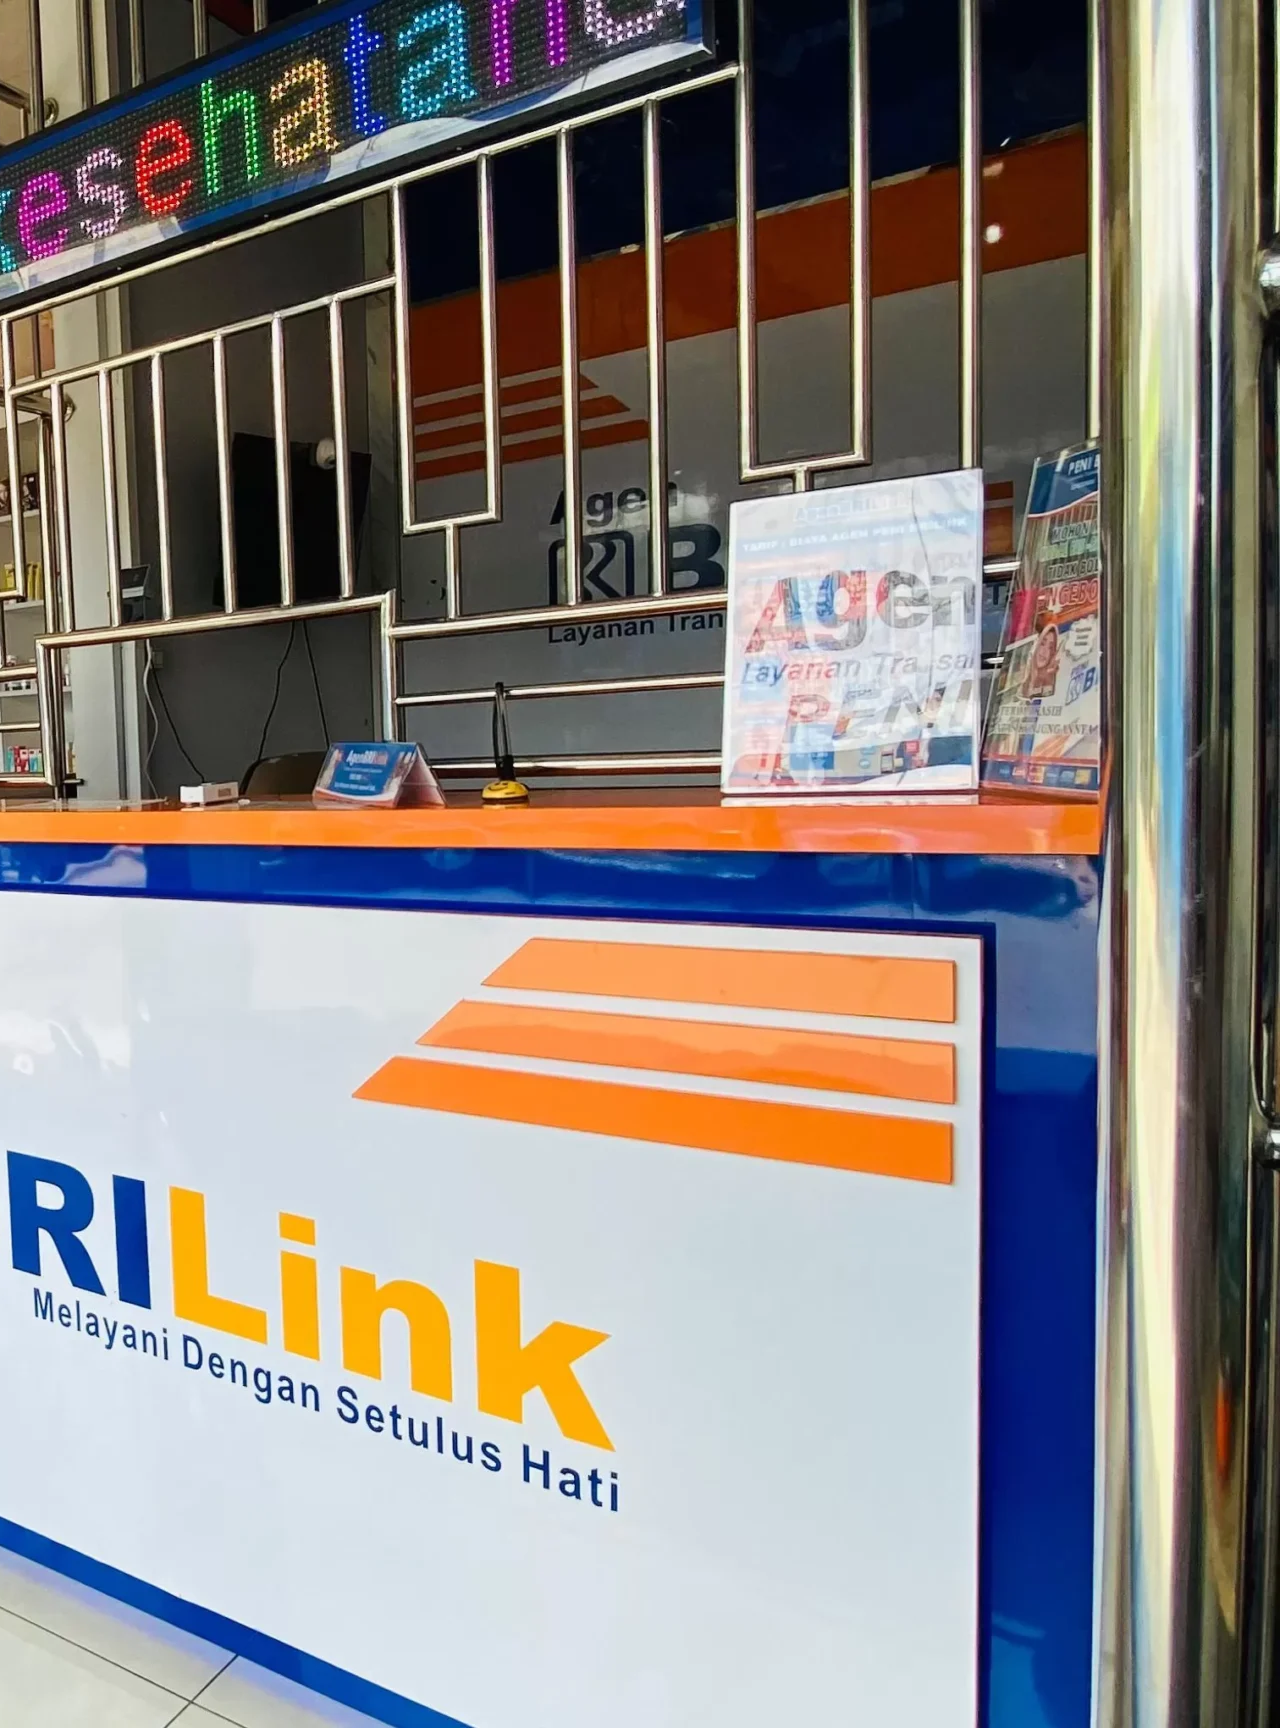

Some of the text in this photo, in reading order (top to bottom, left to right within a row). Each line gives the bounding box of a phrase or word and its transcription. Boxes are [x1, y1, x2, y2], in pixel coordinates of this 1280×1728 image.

[548, 619, 654, 646] Layanan
[33, 1287, 618, 1512] Melayani Dengan Setulus Hati
